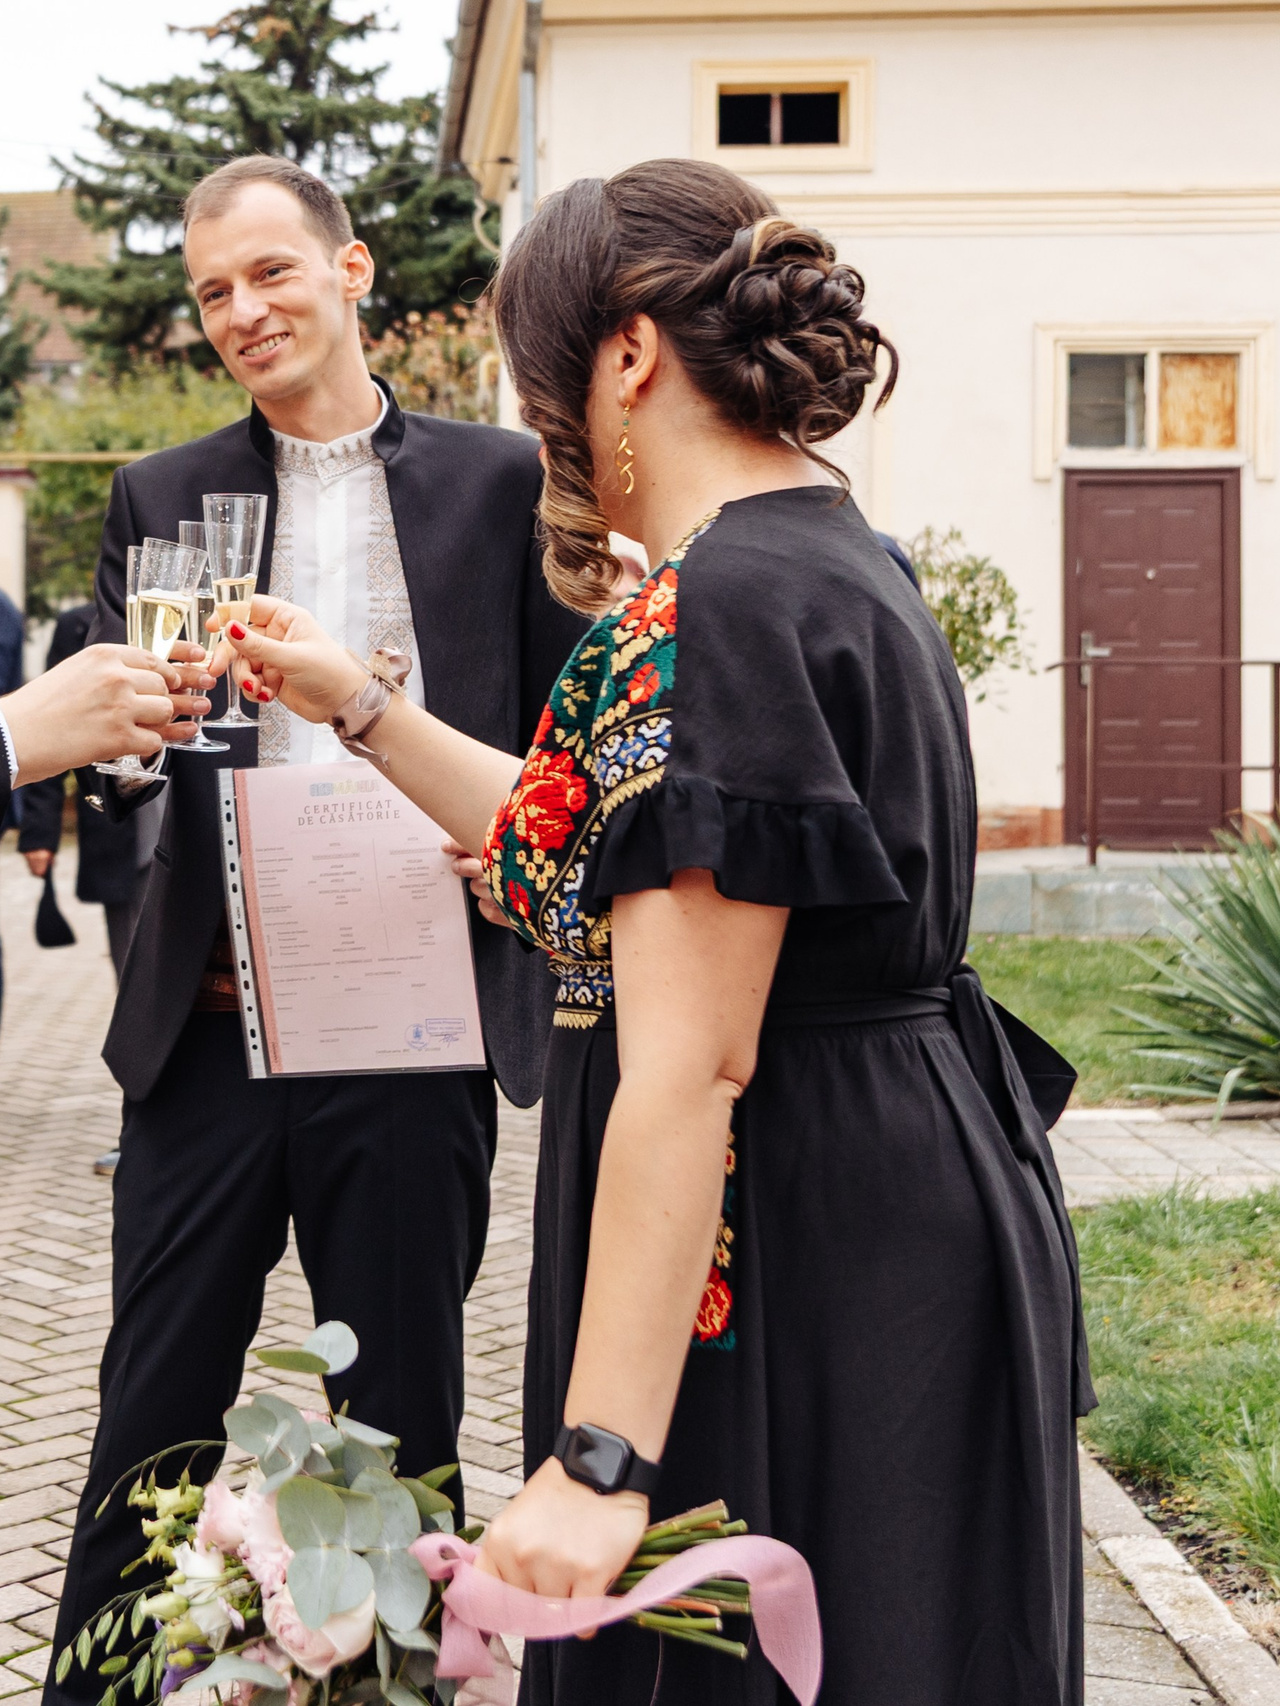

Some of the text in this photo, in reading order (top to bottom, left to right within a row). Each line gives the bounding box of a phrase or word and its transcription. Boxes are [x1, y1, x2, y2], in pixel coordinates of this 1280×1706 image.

[304, 799, 393, 815] CERTIFICAT
[298, 810, 401, 827] DE CĂSĂTORIE
